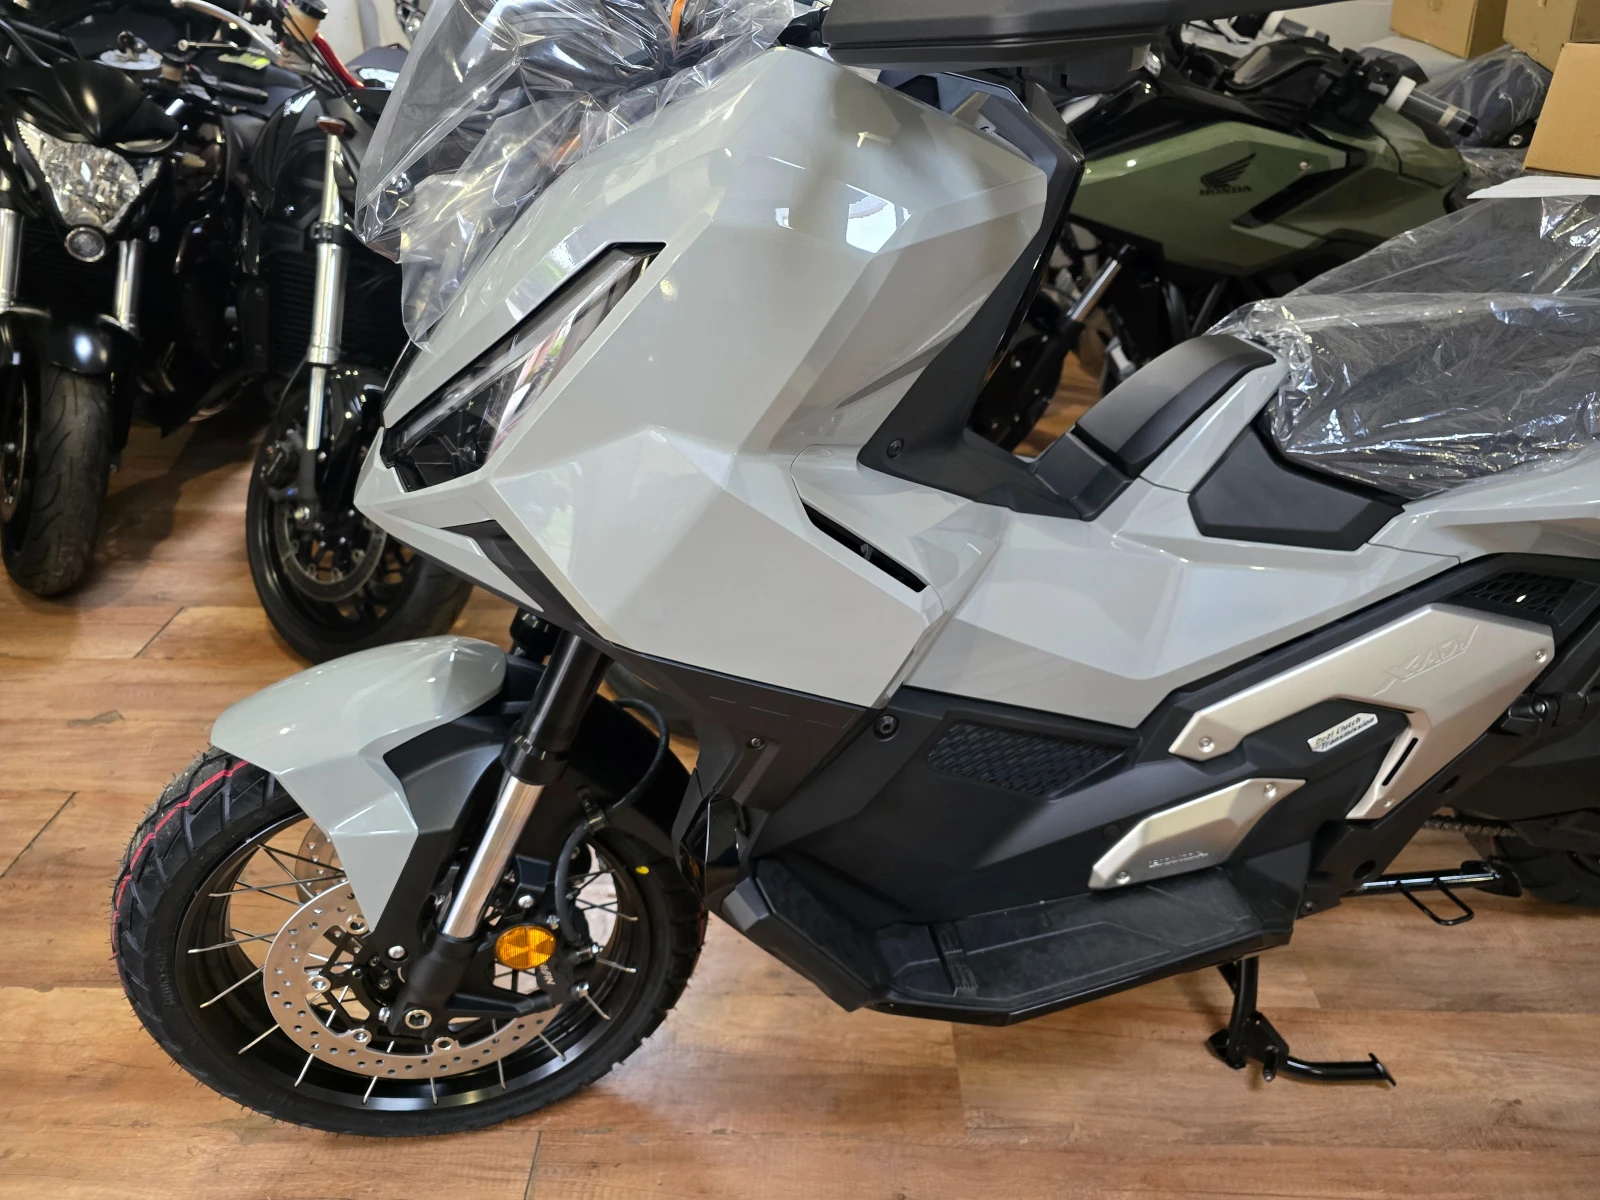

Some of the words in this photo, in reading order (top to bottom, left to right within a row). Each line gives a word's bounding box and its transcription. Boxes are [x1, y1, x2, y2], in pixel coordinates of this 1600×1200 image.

[1199, 185, 1252, 196] HONDA
[1321, 716, 1375, 750] Transmission
[1336, 717, 1361, 734] Clutch
